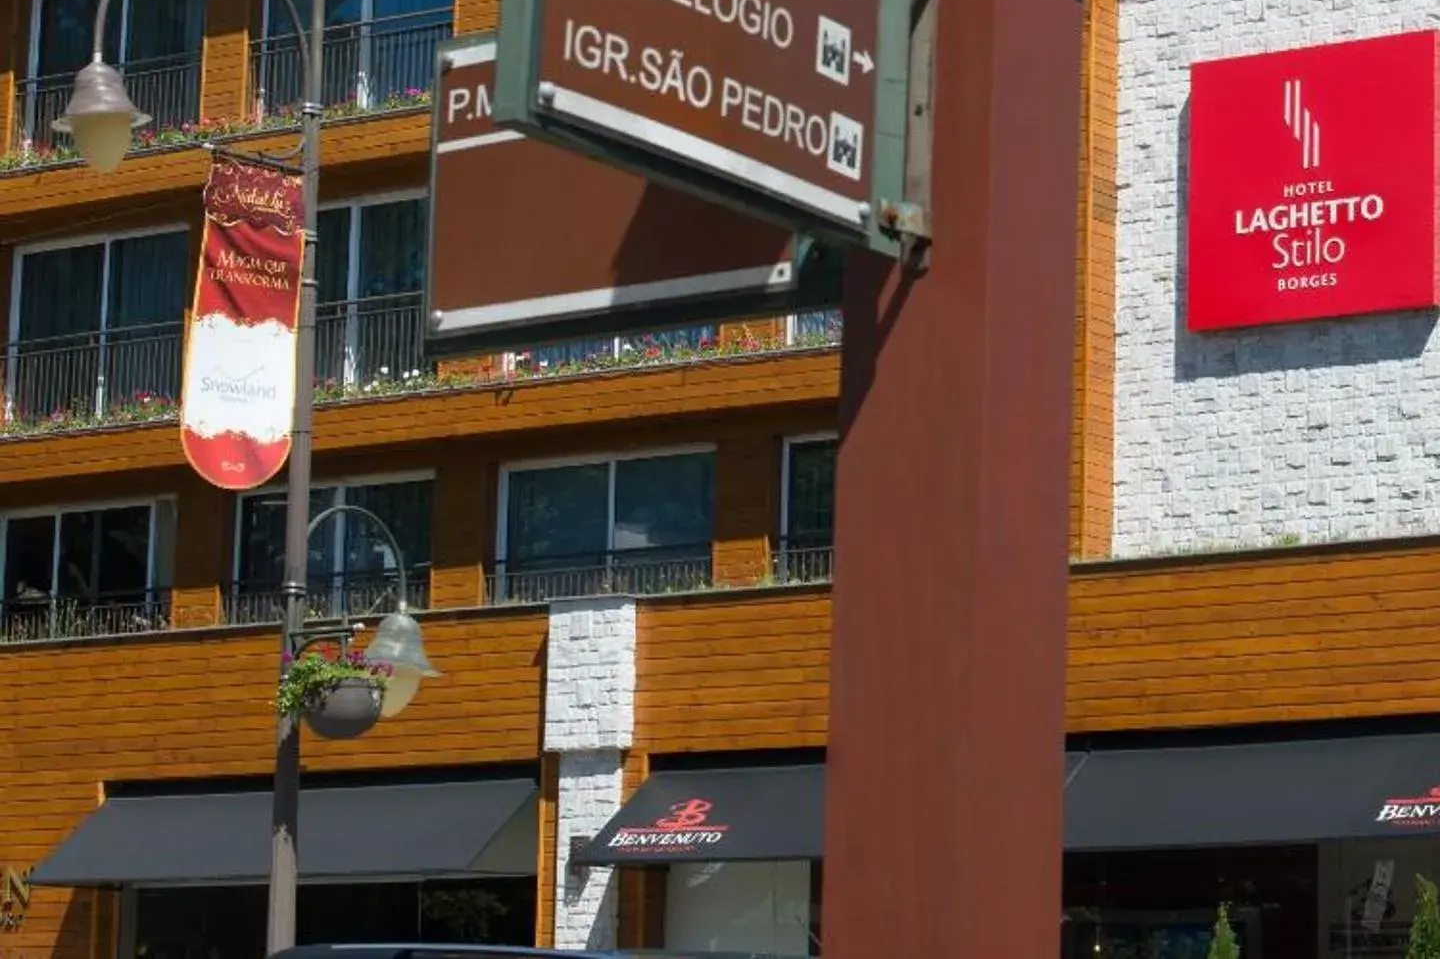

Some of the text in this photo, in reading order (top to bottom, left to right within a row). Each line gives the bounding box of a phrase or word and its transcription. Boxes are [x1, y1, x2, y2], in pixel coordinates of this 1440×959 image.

[563, 18, 828, 156] IGR.SÃO PEDRO
[1283, 180, 1335, 198] HOTEL
[1234, 194, 1384, 235] LAGHETTO
[1271, 228, 1346, 269] Stilo
[1277, 272, 1338, 292] BORGES
[199, 376, 277, 402] Snowland
[608, 831, 722, 847] BENVENUTO
